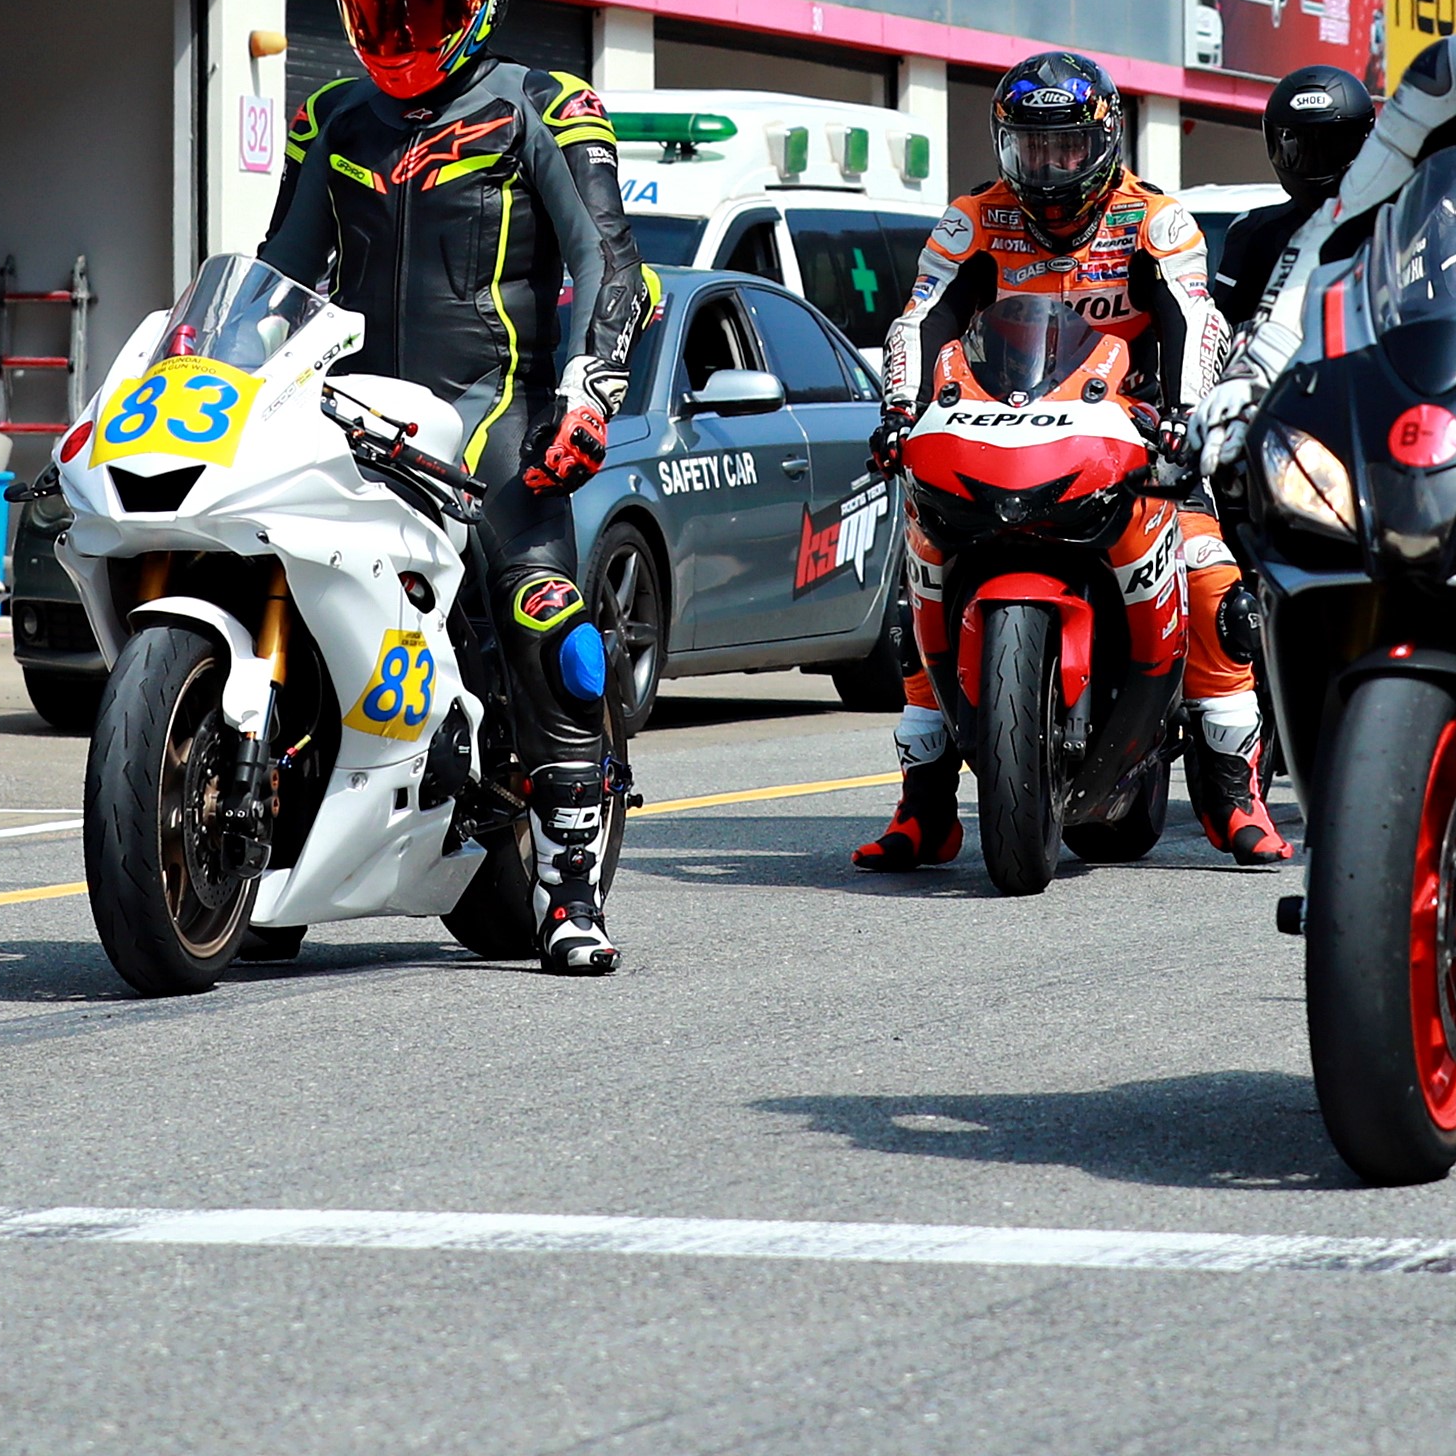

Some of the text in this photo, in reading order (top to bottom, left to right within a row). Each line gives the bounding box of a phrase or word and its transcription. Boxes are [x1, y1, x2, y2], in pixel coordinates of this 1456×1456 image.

[1028, 91, 1069, 105] X-lite
[1296, 96, 1326, 106] SHOEI
[247, 106, 268, 152] 32
[1016, 262, 1046, 282] GAS
[162, 356, 202, 366] HYUNDAI
[168, 363, 190, 373] GUN
[191, 363, 217, 375] WOO
[104, 374, 241, 445] 83
[946, 412, 1074, 427] REPSOL
[658, 452, 758, 496] SAFETY CAR
[362, 646, 435, 726] 83
